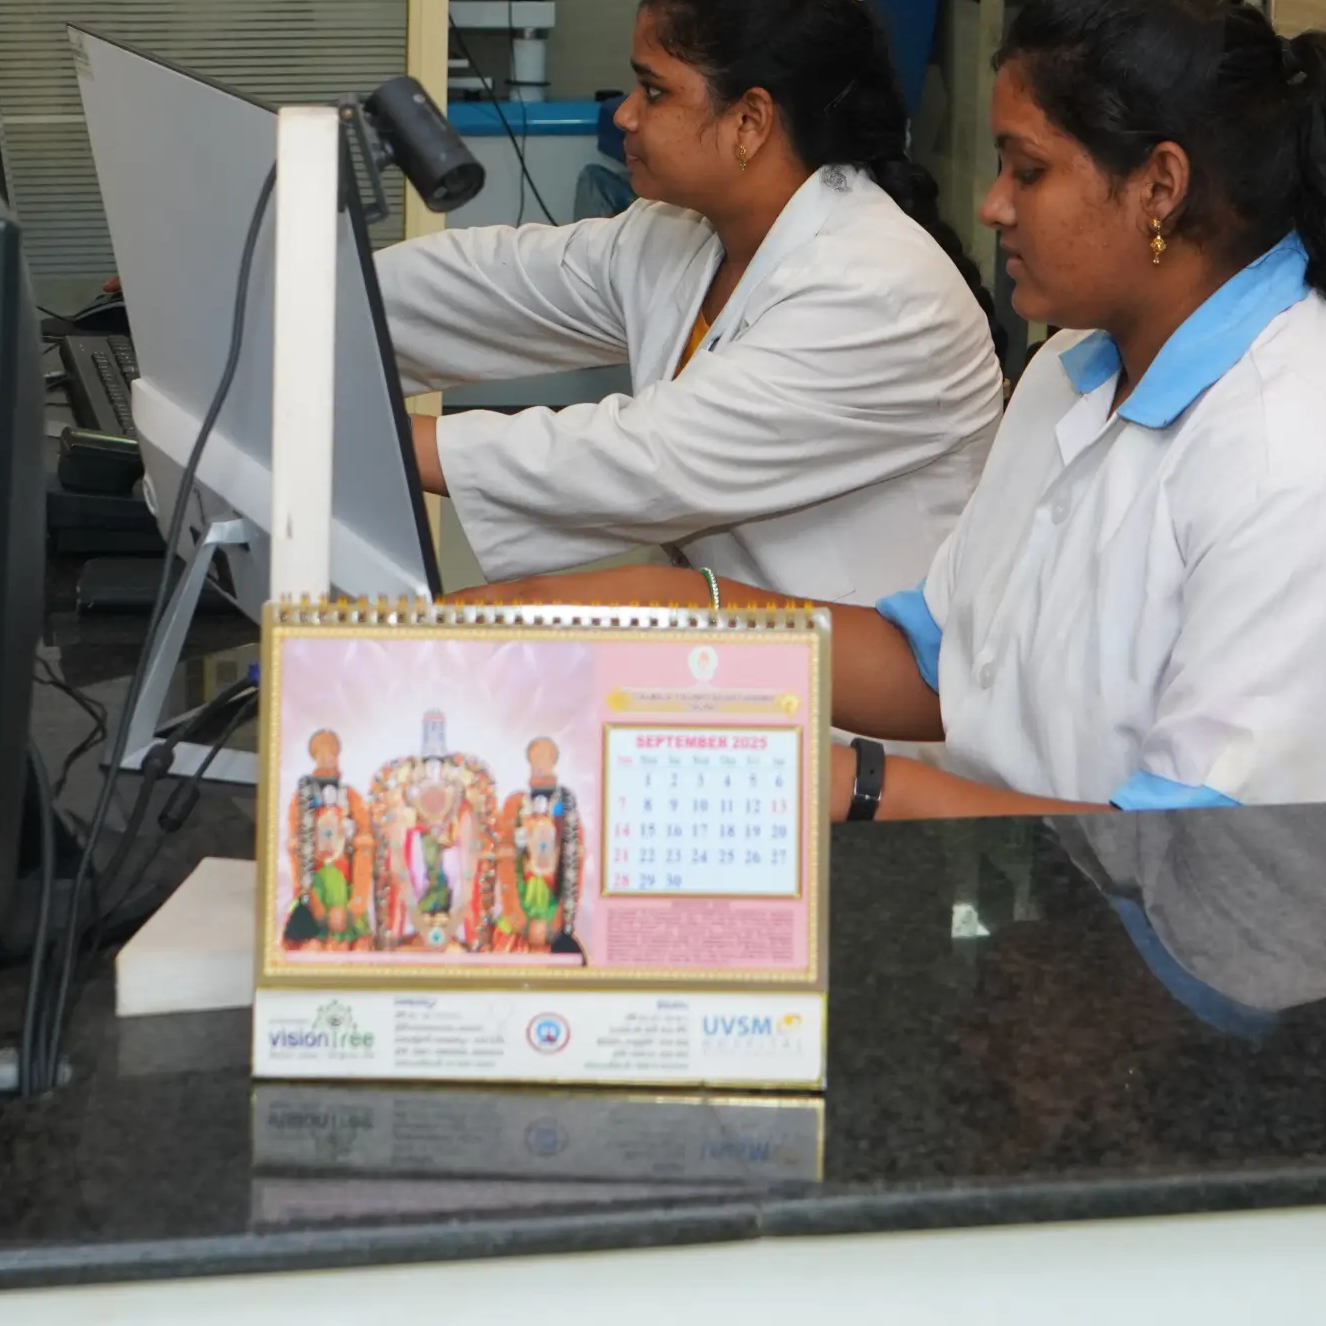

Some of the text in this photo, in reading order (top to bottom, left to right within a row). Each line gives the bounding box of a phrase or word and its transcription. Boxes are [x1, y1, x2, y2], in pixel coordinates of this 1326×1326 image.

[636, 734, 768, 751] SEPTEMBER 2025
[702, 1014, 772, 1036] UVSM
[268, 1028, 375, 1049] visionTree
